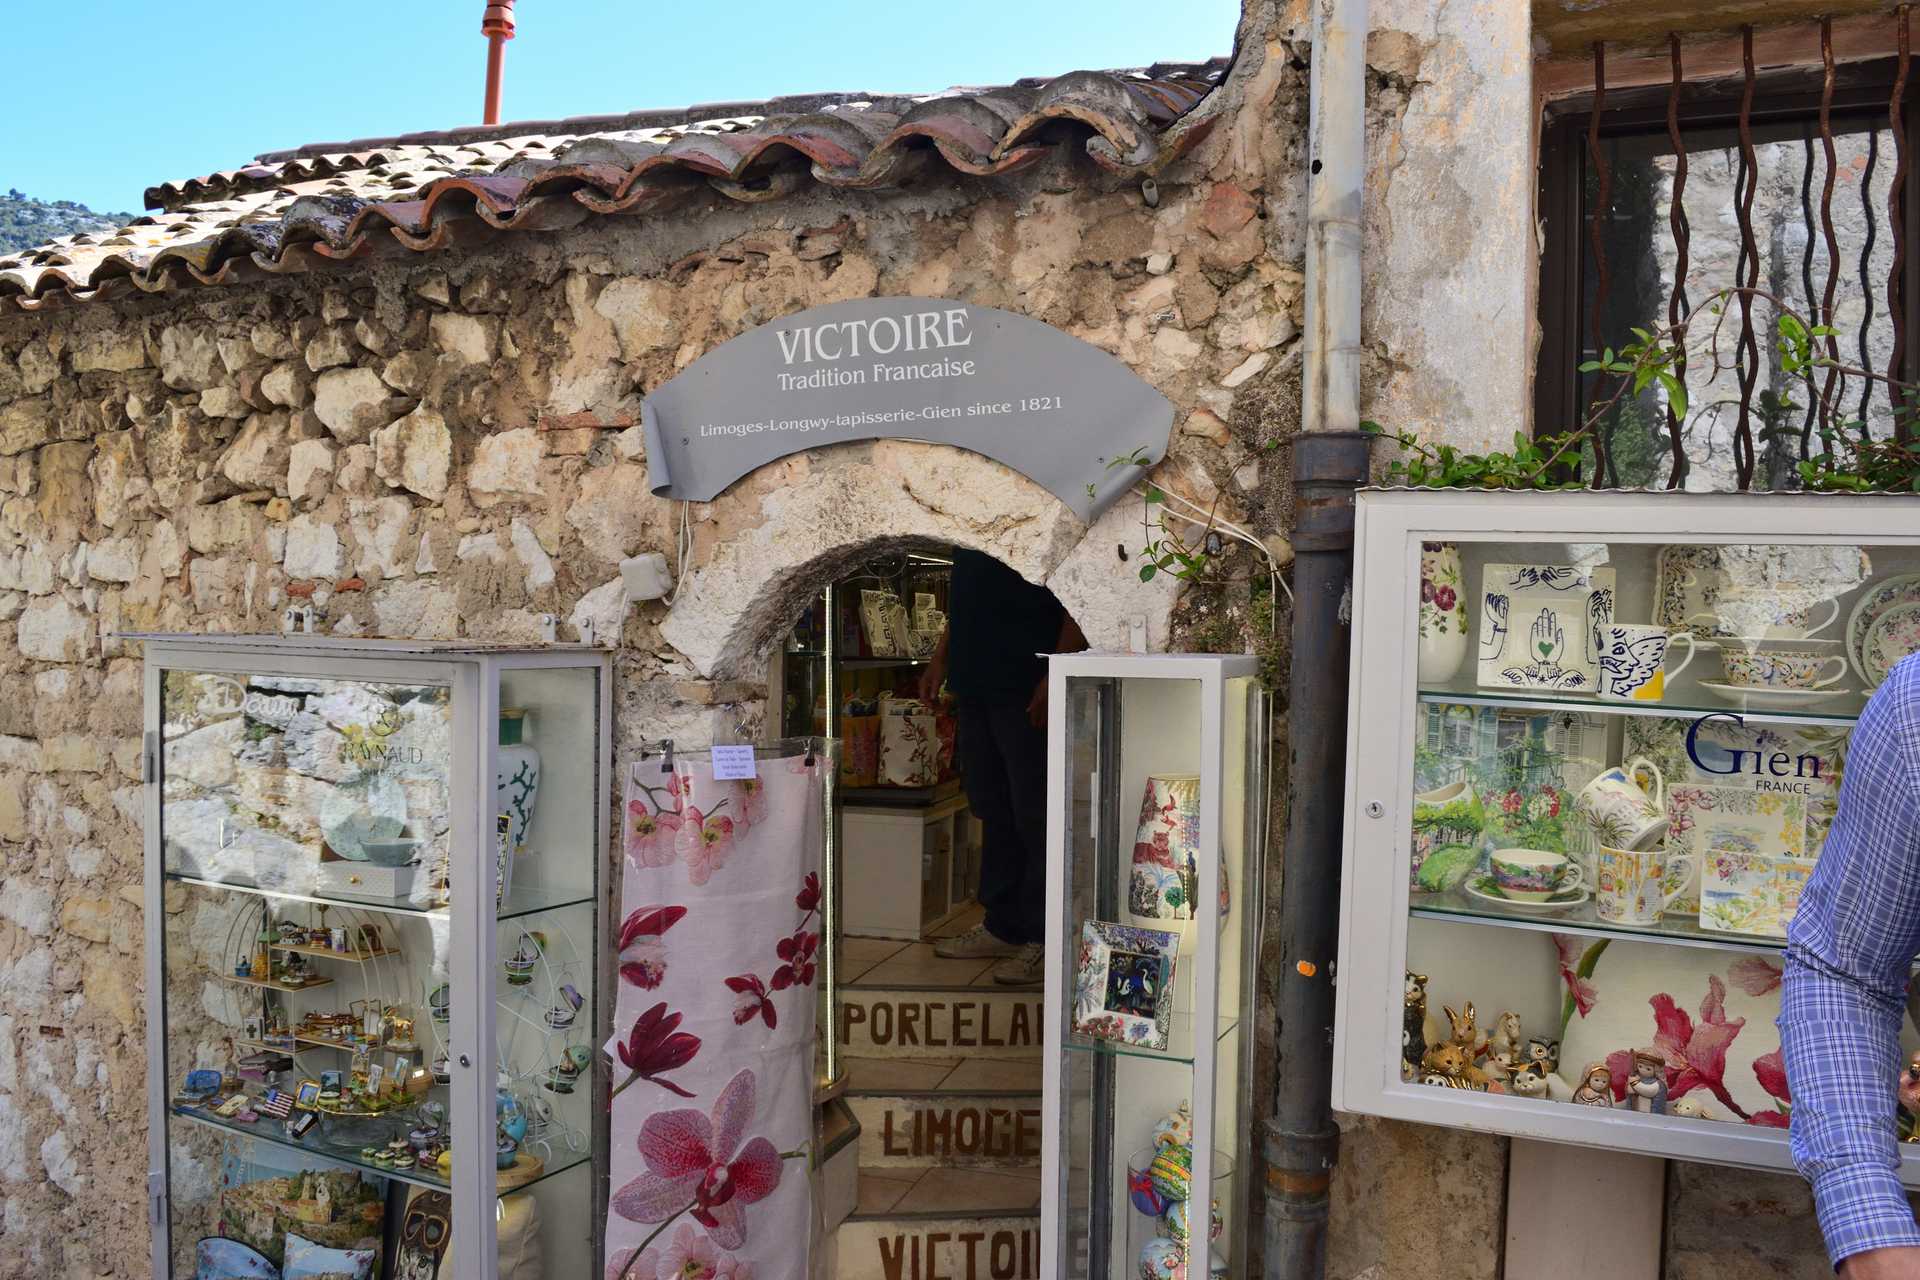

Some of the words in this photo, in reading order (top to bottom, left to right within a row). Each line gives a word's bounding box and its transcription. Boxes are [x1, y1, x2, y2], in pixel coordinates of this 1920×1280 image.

[776, 308, 973, 365] VICTOIRE
[777, 367, 866, 391] Tradition
[873, 357, 976, 382] Francaise
[967, 402, 1012, 416] since
[1018, 396, 1064, 412] 1821
[1686, 712, 1822, 778] Gien
[1755, 779, 1811, 795] FRANCE
[878, 1229, 1040, 1280] VICTOI
